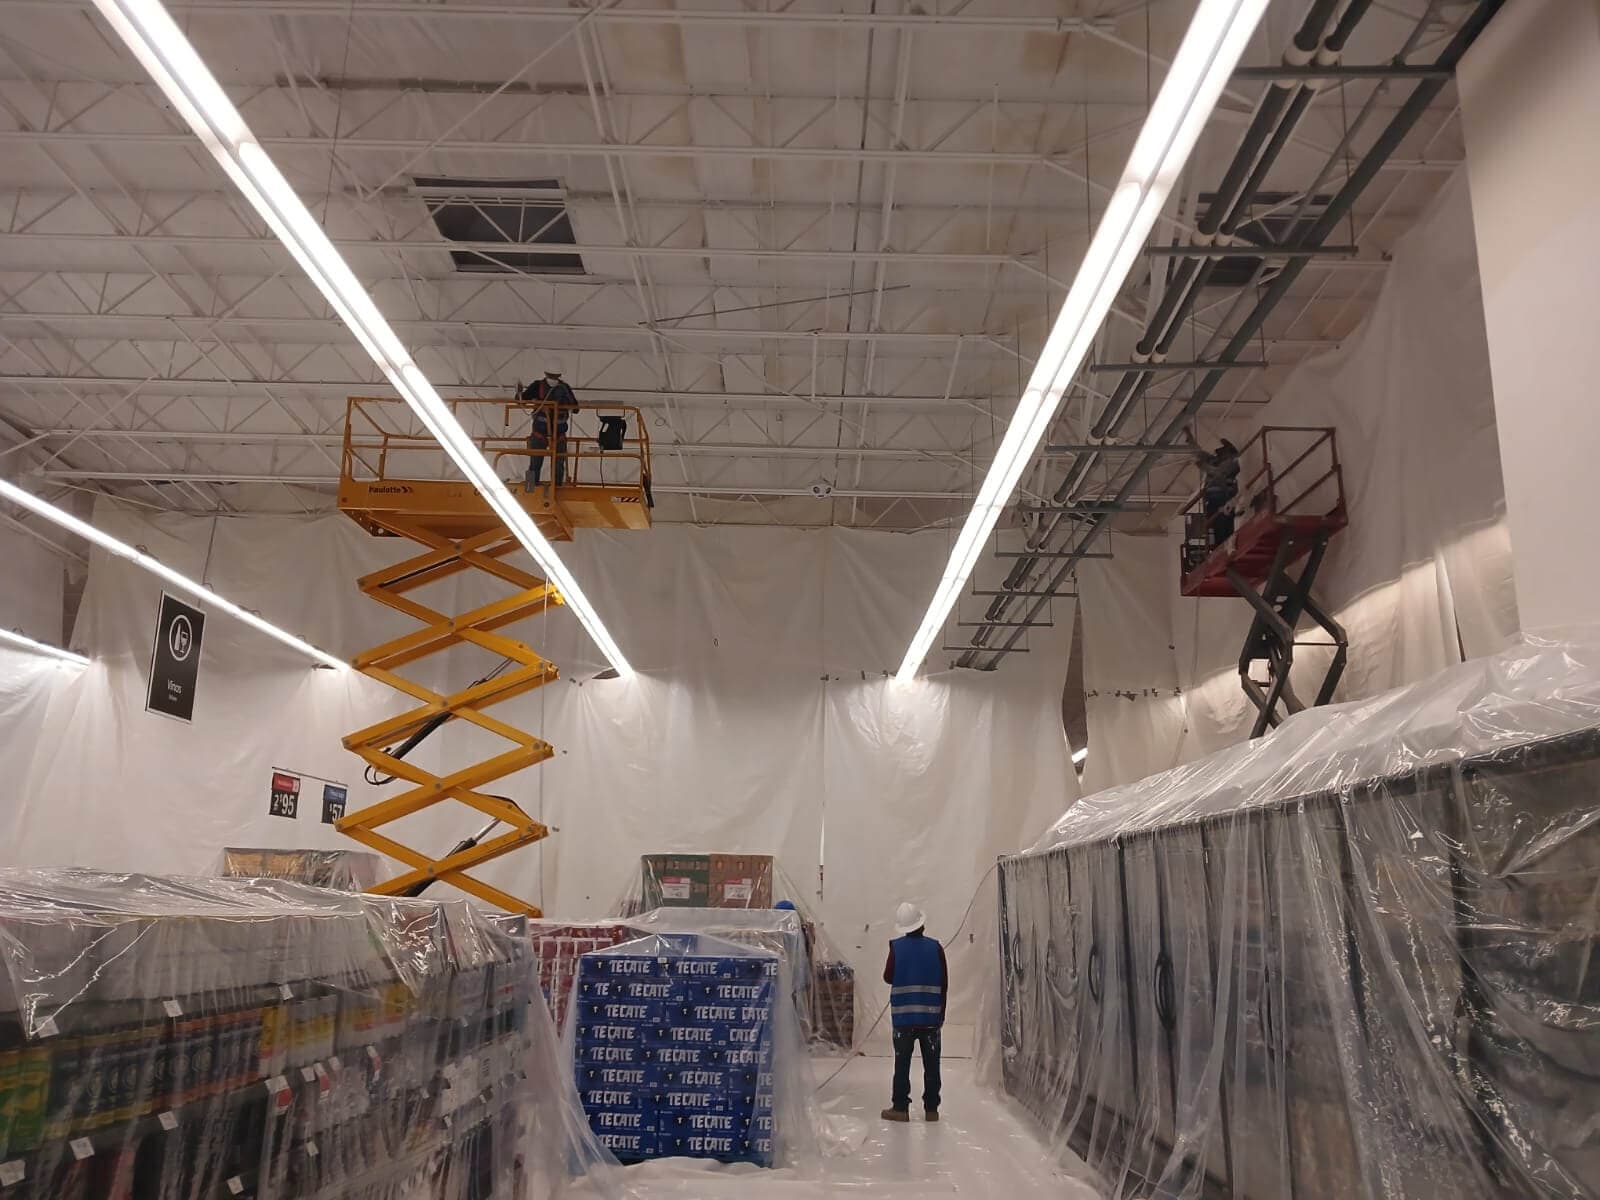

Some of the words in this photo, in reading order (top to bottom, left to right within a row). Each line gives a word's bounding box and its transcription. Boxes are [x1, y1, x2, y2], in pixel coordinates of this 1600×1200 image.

[609, 960, 651, 973] TECATE
[676, 962, 719, 974] TECATE
[629, 983, 671, 997] TECATE
[717, 985, 760, 998] TECATE
[605, 1004, 648, 1018] TECATE
[694, 1006, 736, 1019] TECATE
[741, 1006, 768, 1020] CATE
[592, 1026, 635, 1039] TECATE
[671, 1027, 713, 1041] TECATE
[730, 1029, 758, 1042] CATE
[591, 1047, 634, 1060] TECATE
[657, 1048, 700, 1062] TECATE
[725, 1049, 767, 1064] TECATE
[601, 1069, 645, 1083] TECATE
[680, 1071, 723, 1086] TECATE
[588, 1090, 632, 1104] TECATE
[666, 1092, 711, 1106] TECATE
[598, 1113, 641, 1126] TECATE
[689, 1115, 733, 1129] TECATE
[688, 1137, 732, 1151] TECATE
